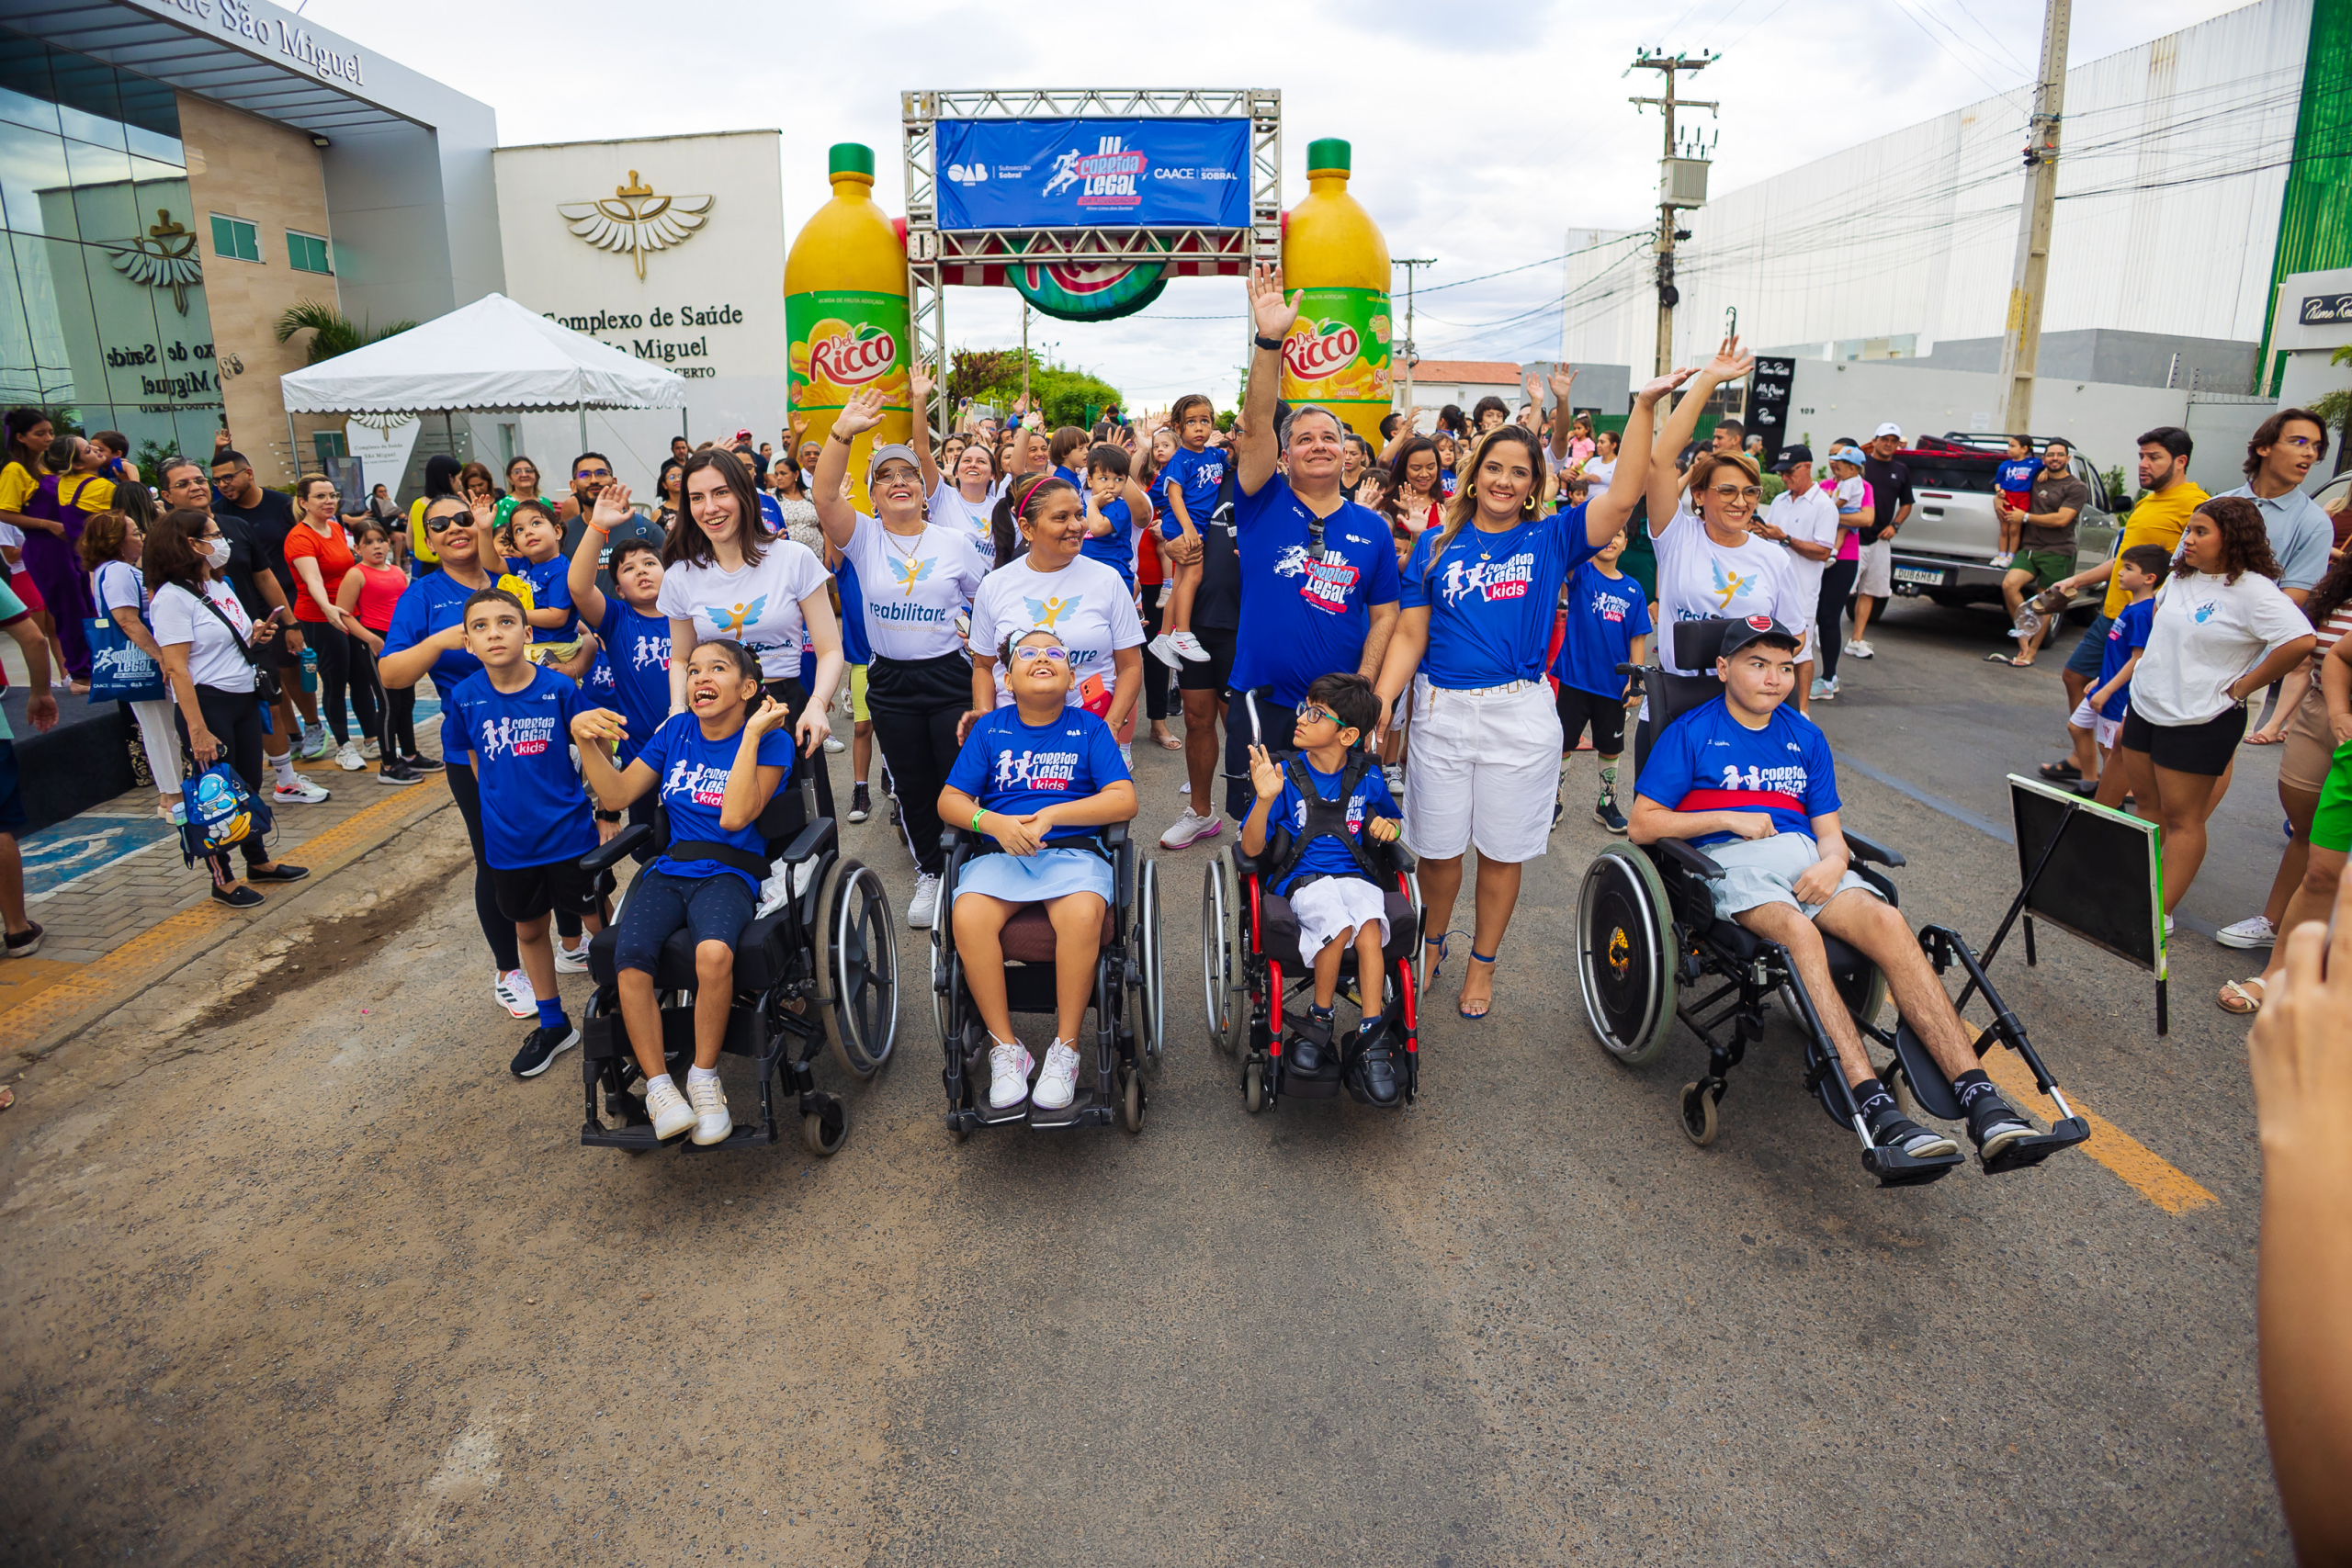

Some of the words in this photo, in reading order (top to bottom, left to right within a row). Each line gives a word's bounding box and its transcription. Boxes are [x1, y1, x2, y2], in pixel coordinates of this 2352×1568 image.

[220, 0, 272, 45] São
[277, 19, 365, 86] Miguel
[947, 163, 989, 182] OAB
[1153, 168, 1194, 179] CAACE
[1201, 172, 1238, 180] SOBRAL
[650, 307, 673, 327] de
[681, 304, 743, 326] Saúde
[2305, 299, 2335, 320] Prime
[831, 332, 855, 349] Del
[1296, 328, 1317, 346] Del
[632, 336, 708, 363] Miguel
[674, 367, 716, 378] CERTO
[1492, 582, 1525, 599] kids
[869, 602, 945, 622] reabilitare
[518, 741, 546, 754] kids
[1036, 779, 1065, 790] kids
